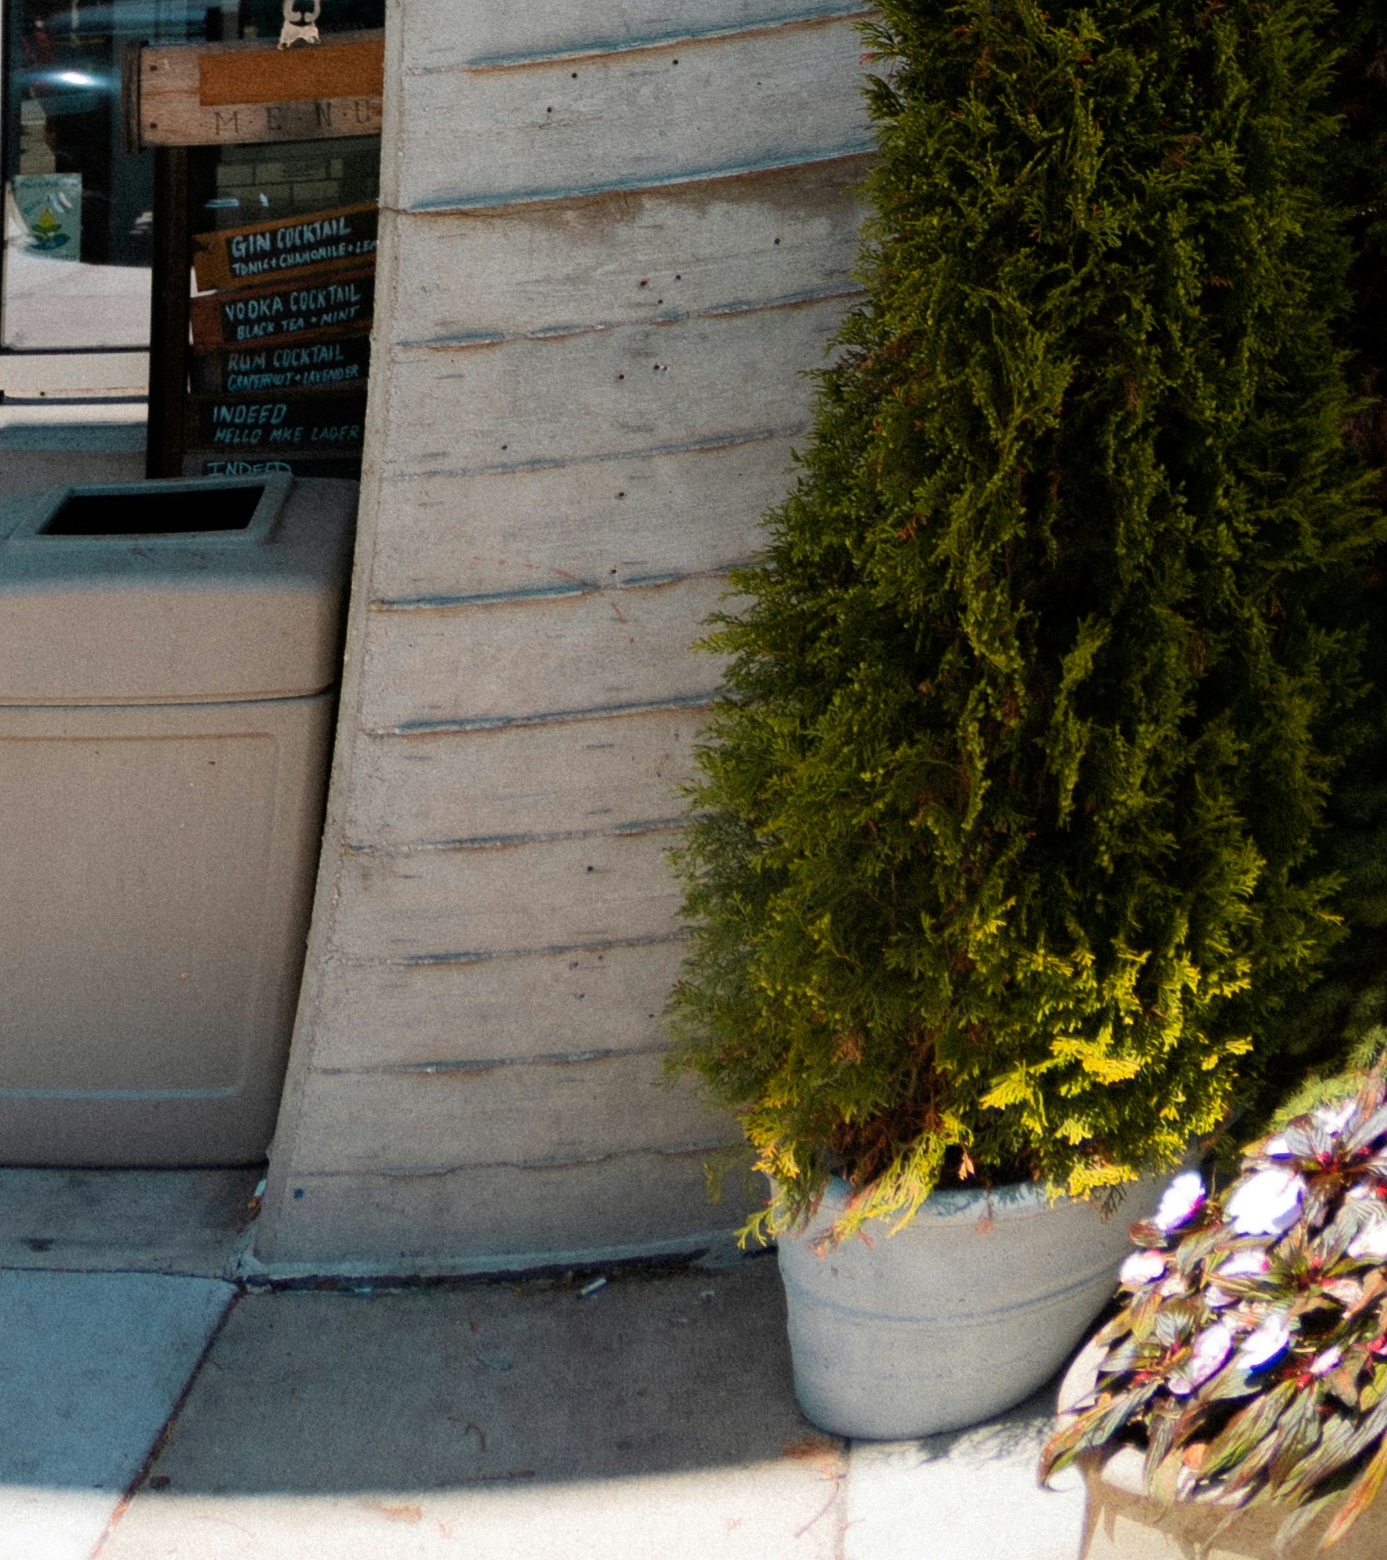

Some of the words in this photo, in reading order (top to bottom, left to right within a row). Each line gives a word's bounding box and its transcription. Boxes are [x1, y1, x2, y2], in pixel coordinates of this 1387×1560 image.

[231, 231, 271, 259] GIN
[277, 216, 352, 249] COCKTAIL
[225, 296, 284, 322] VODKA
[289, 283, 362, 312] COCKTAIL
[236, 320, 275, 341] BLACK
[281, 317, 305, 331] TEA
[320, 305, 360, 326] MINT
[227, 351, 266, 372] RUM
[273, 344, 344, 369] COCKTAIL
[302, 364, 359, 386] LAVENDER
[212, 403, 288, 425] INDEED
[214, 427, 262, 444] HELLO
[269, 426, 304, 442] MKE
[310, 424, 360, 442] LAGER
